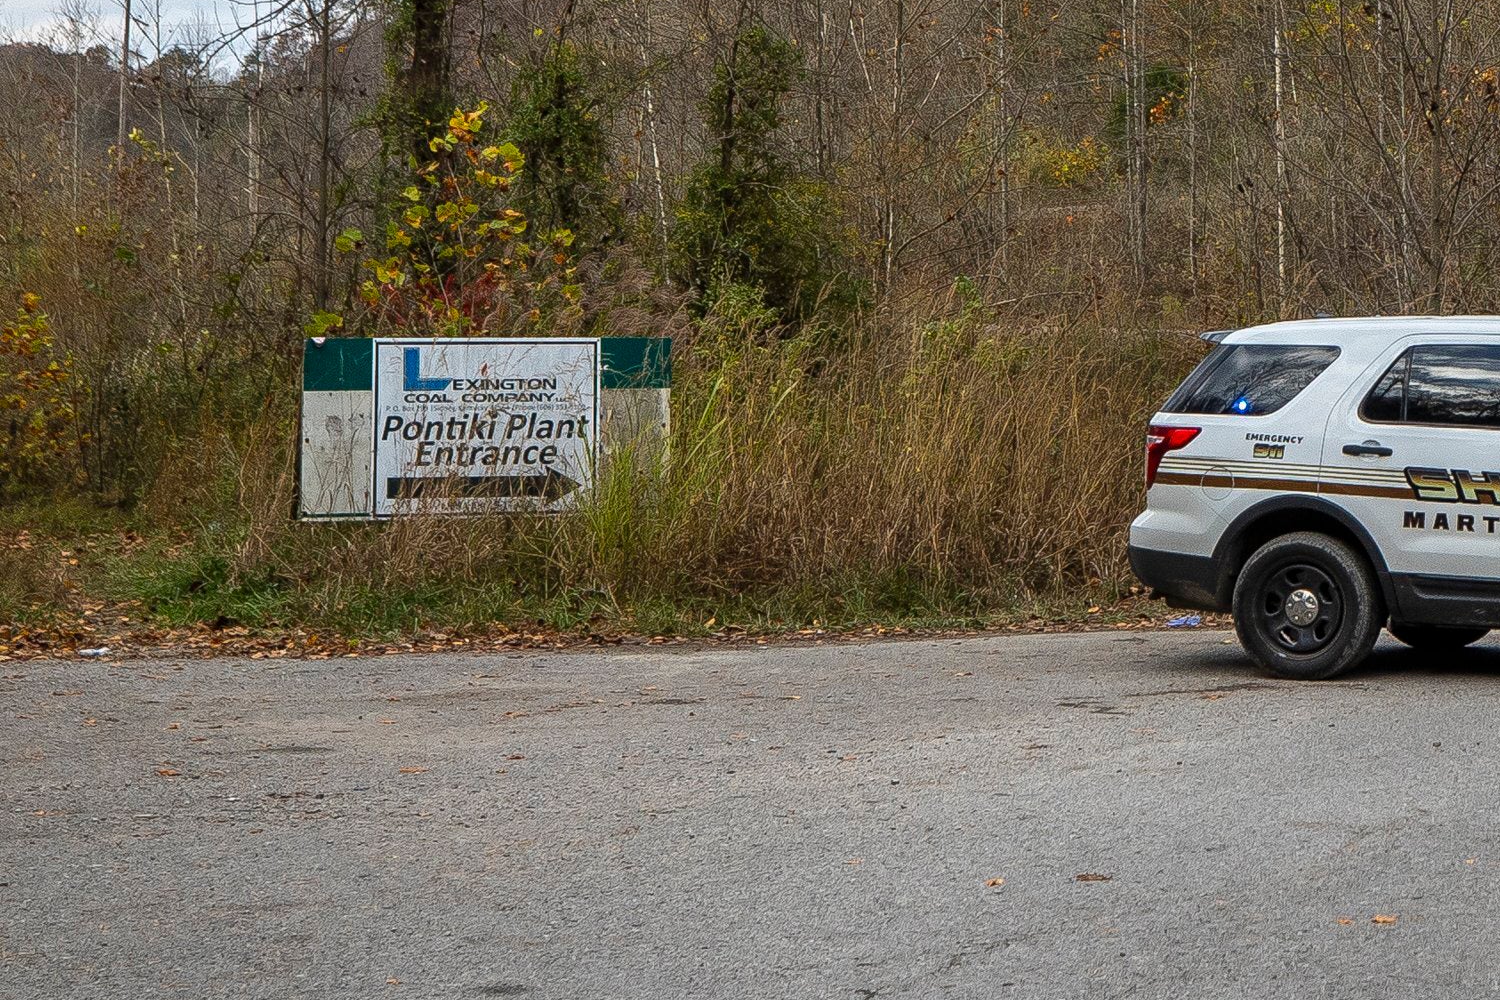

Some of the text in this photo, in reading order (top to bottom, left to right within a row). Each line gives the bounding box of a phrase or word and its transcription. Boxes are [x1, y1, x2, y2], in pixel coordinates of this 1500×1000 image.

[403, 347, 556, 391] LEXINGTON
[404, 394, 453, 403] COAL
[461, 393, 556, 402] COMPANY
[382, 412, 589, 440] Pontiki Plant
[1245, 433, 1304, 444] EMERGENCY
[415, 441, 557, 467] Entrance
[1253, 443, 1286, 459] 911
